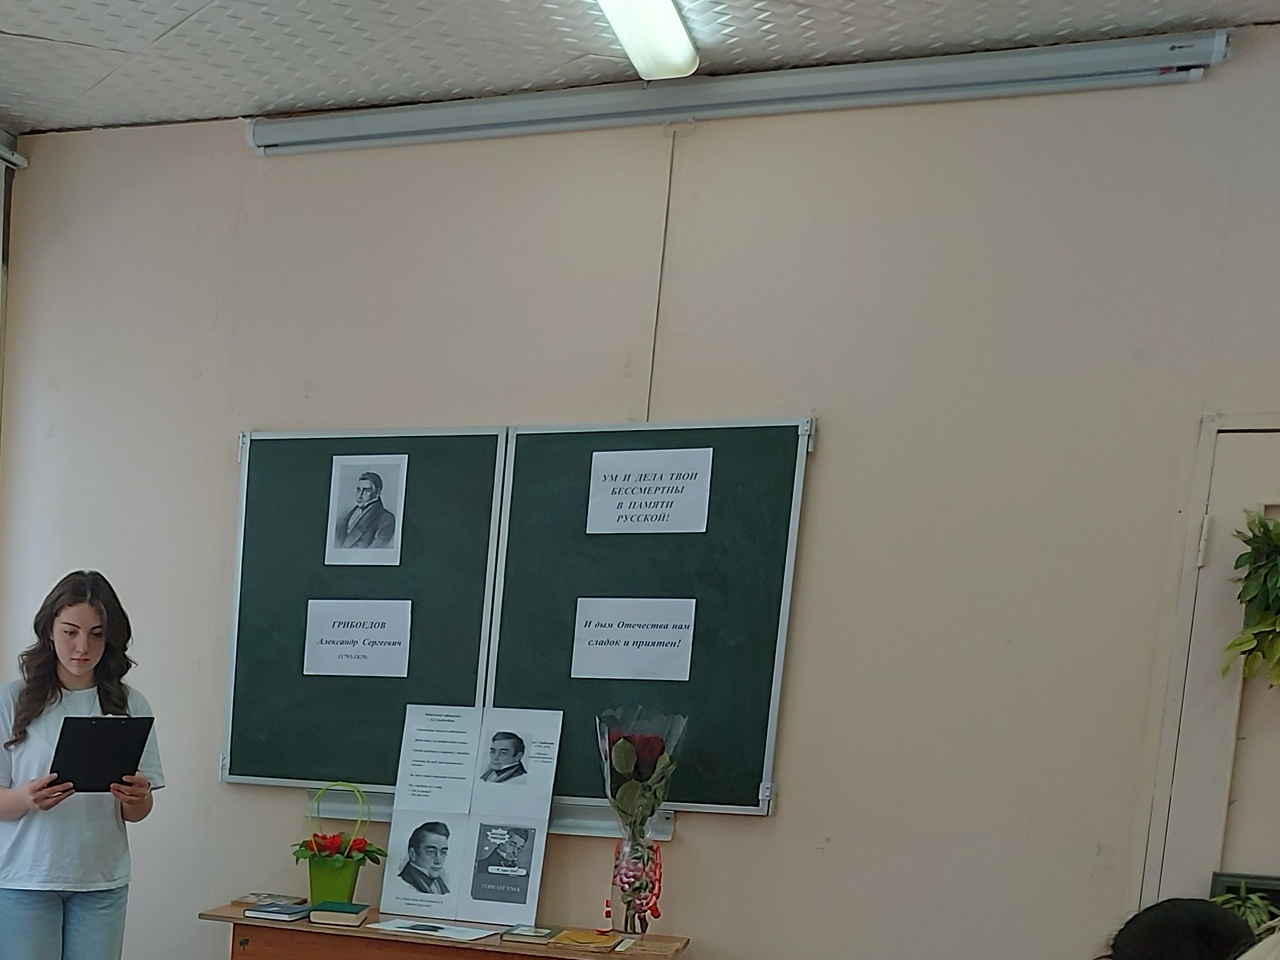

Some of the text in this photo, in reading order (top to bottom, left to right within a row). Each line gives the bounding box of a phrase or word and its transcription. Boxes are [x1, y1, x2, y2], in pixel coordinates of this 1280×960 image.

[601, 473, 619, 482] УМ
[623, 473, 632, 482] И
[635, 473, 664, 483] ДЕЛА
[611, 486, 685, 496] БЕССМЕРТНЫ
[616, 500, 674, 510] В ПАМЯТИ
[616, 512, 670, 523] РУССКОЙ!
[331, 621, 387, 629] ГРИБОЕДОВ
[583, 620, 592, 629] И
[594, 621, 613, 629] дым
[616, 621, 669, 630] Отечества
[317, 638, 402, 648] Александр Сергеевич
[587, 638, 621, 646] сладок
[631, 639, 682, 649] приятен!
